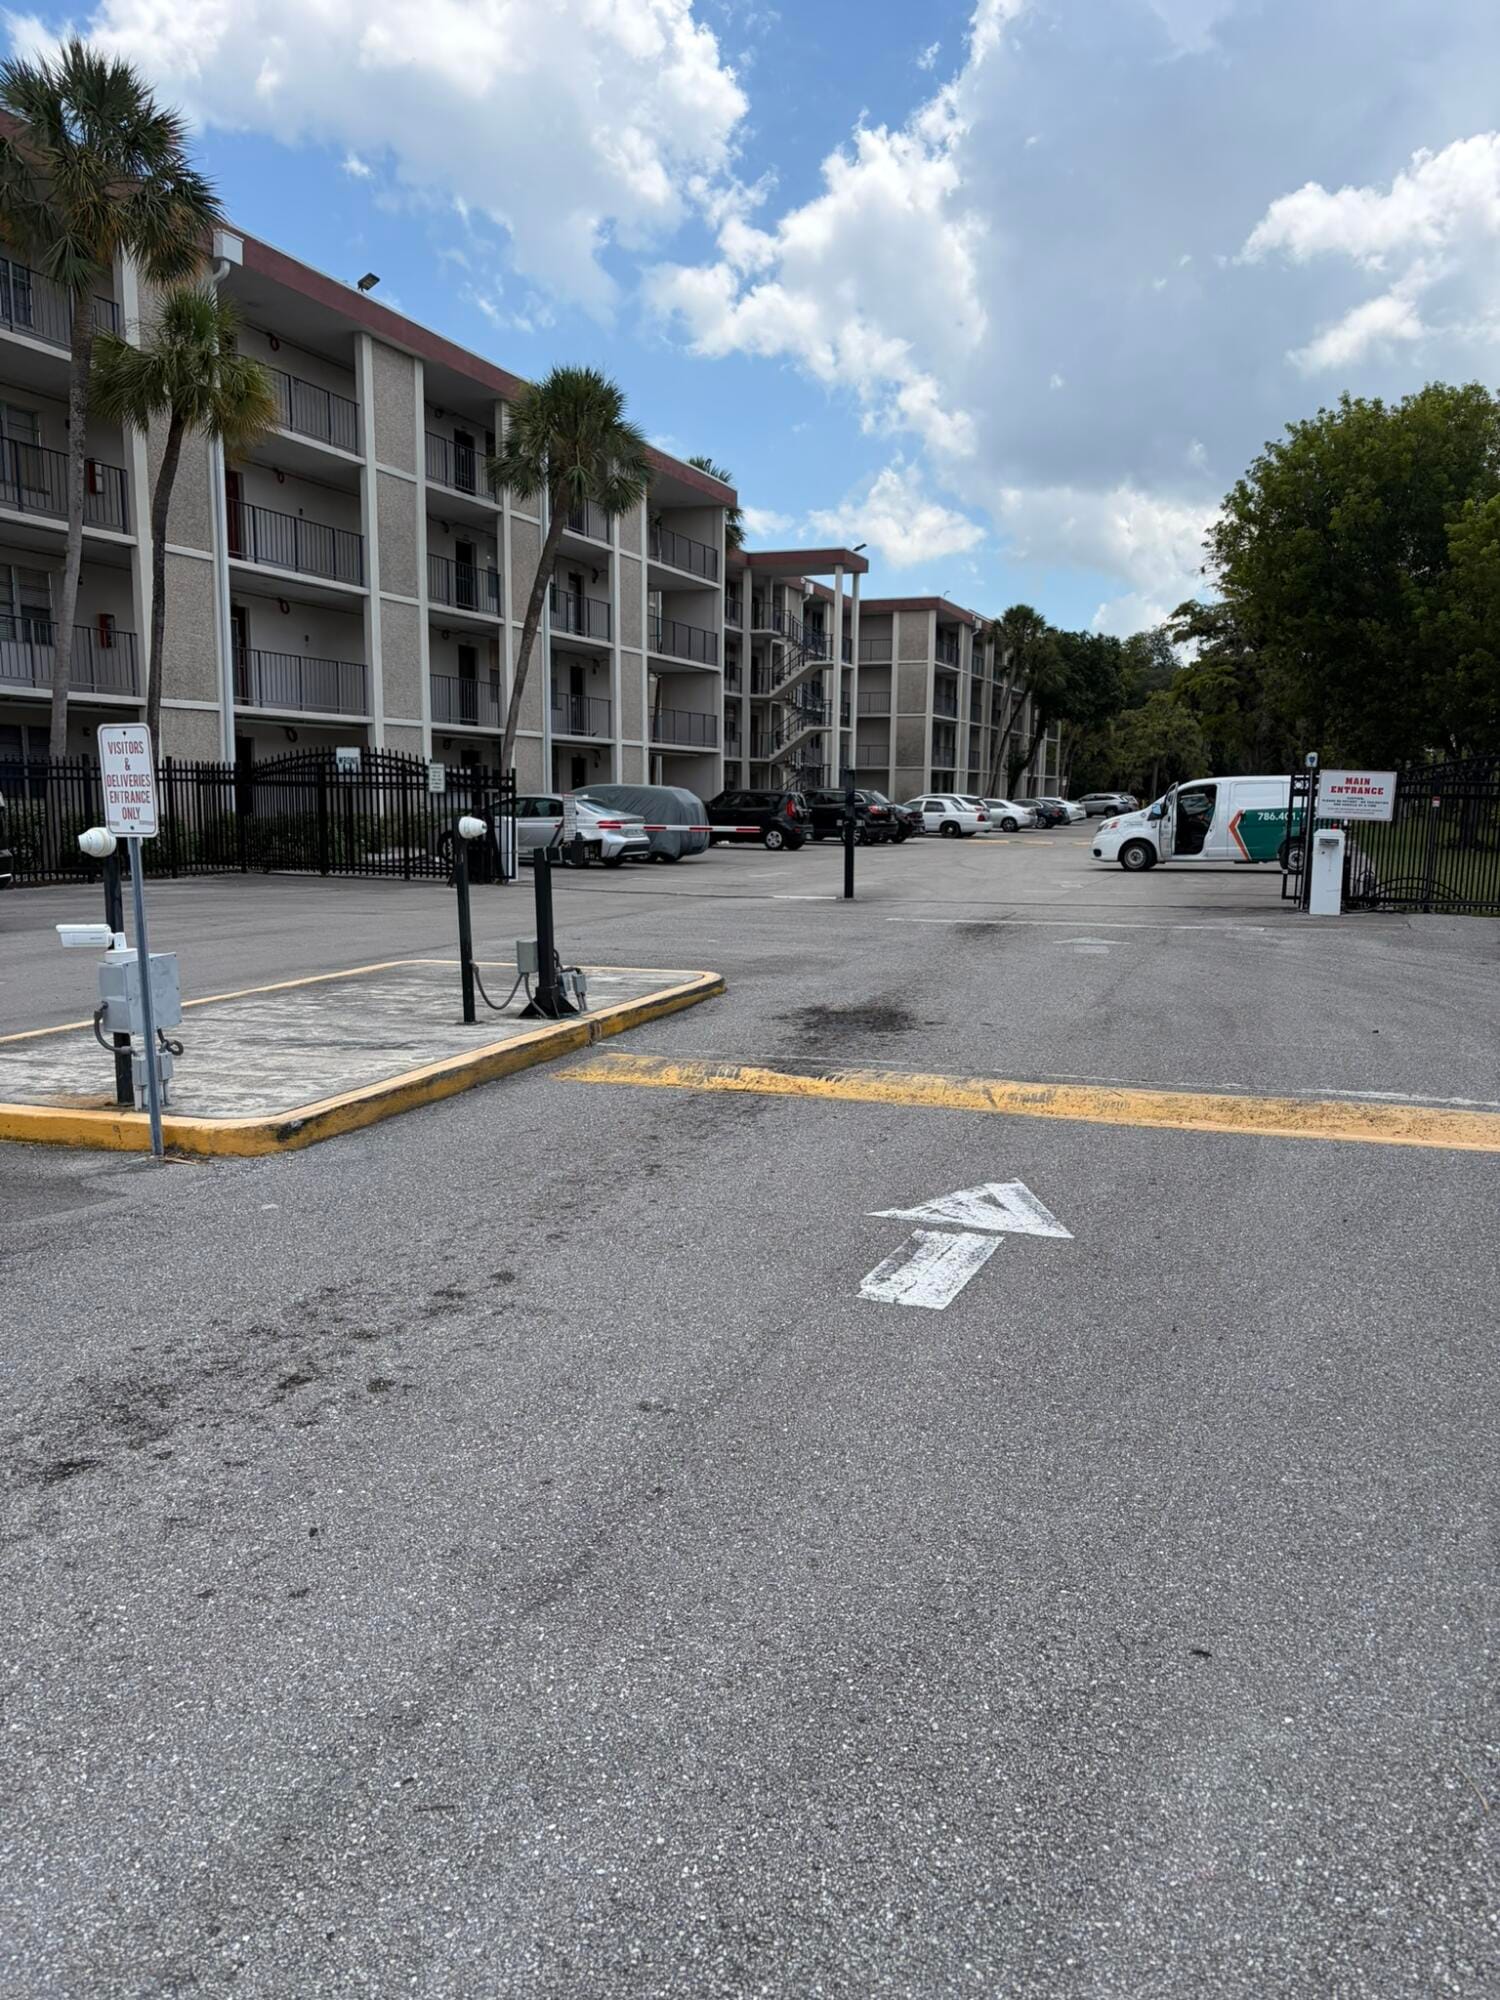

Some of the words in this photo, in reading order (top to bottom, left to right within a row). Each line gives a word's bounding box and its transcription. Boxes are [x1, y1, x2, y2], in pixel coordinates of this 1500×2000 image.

[107, 741, 144, 754] VISITORS
[124, 757, 131, 771] &
[106, 774, 151, 787] DELIVERIES
[1345, 777, 1371, 785] MAIN
[1330, 786, 1384, 795] ENTRANCE
[109, 791, 151, 804] ENTRANCE
[122, 807, 141, 820] ONLY
